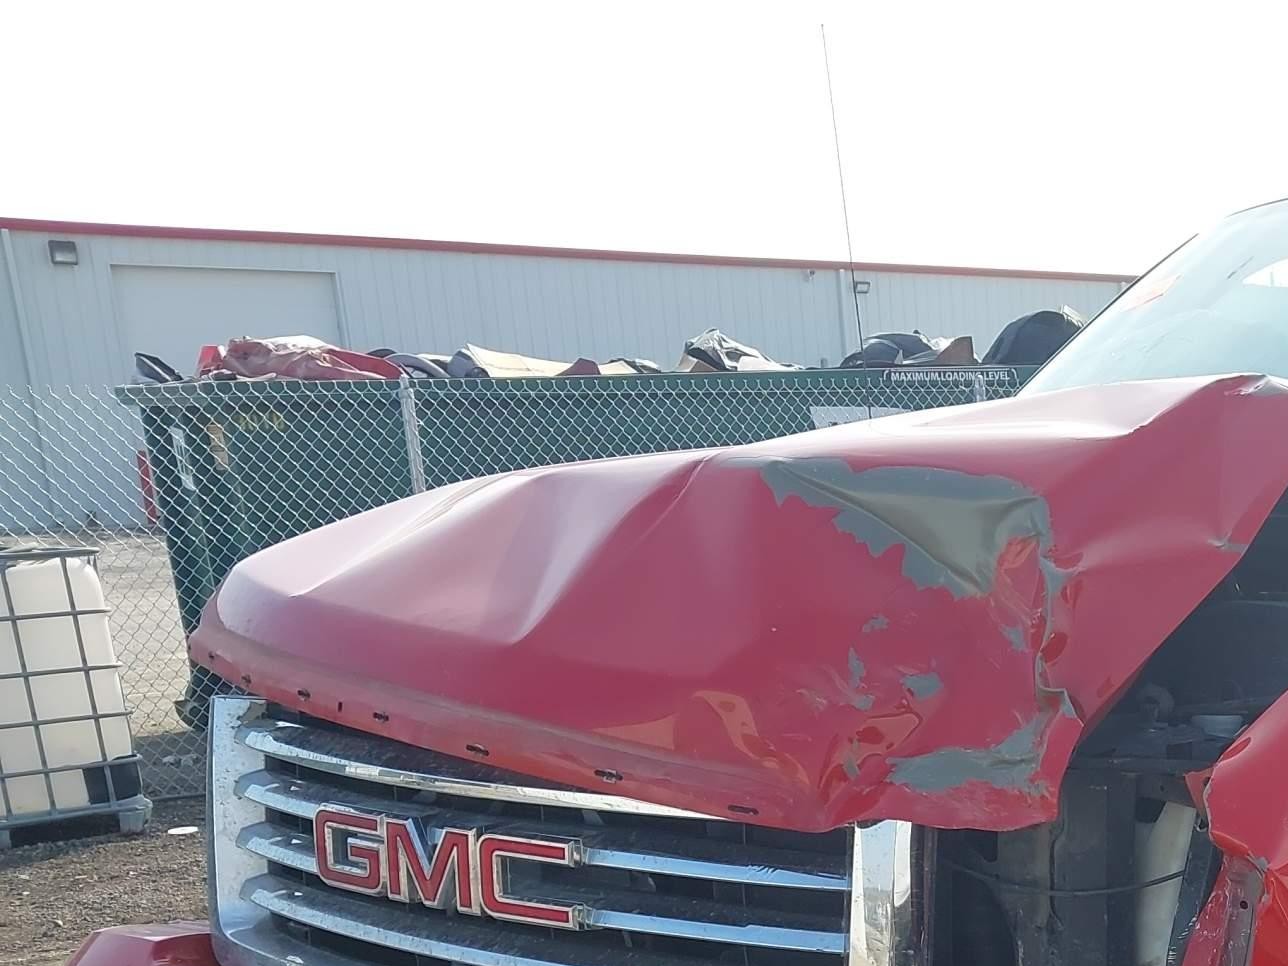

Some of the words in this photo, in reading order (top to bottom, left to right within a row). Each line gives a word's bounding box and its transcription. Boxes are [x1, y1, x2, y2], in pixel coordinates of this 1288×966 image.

[890, 371, 939, 381] MAXIMUM
[984, 371, 1010, 380] LEVEL
[313, 801, 584, 931] GMC
